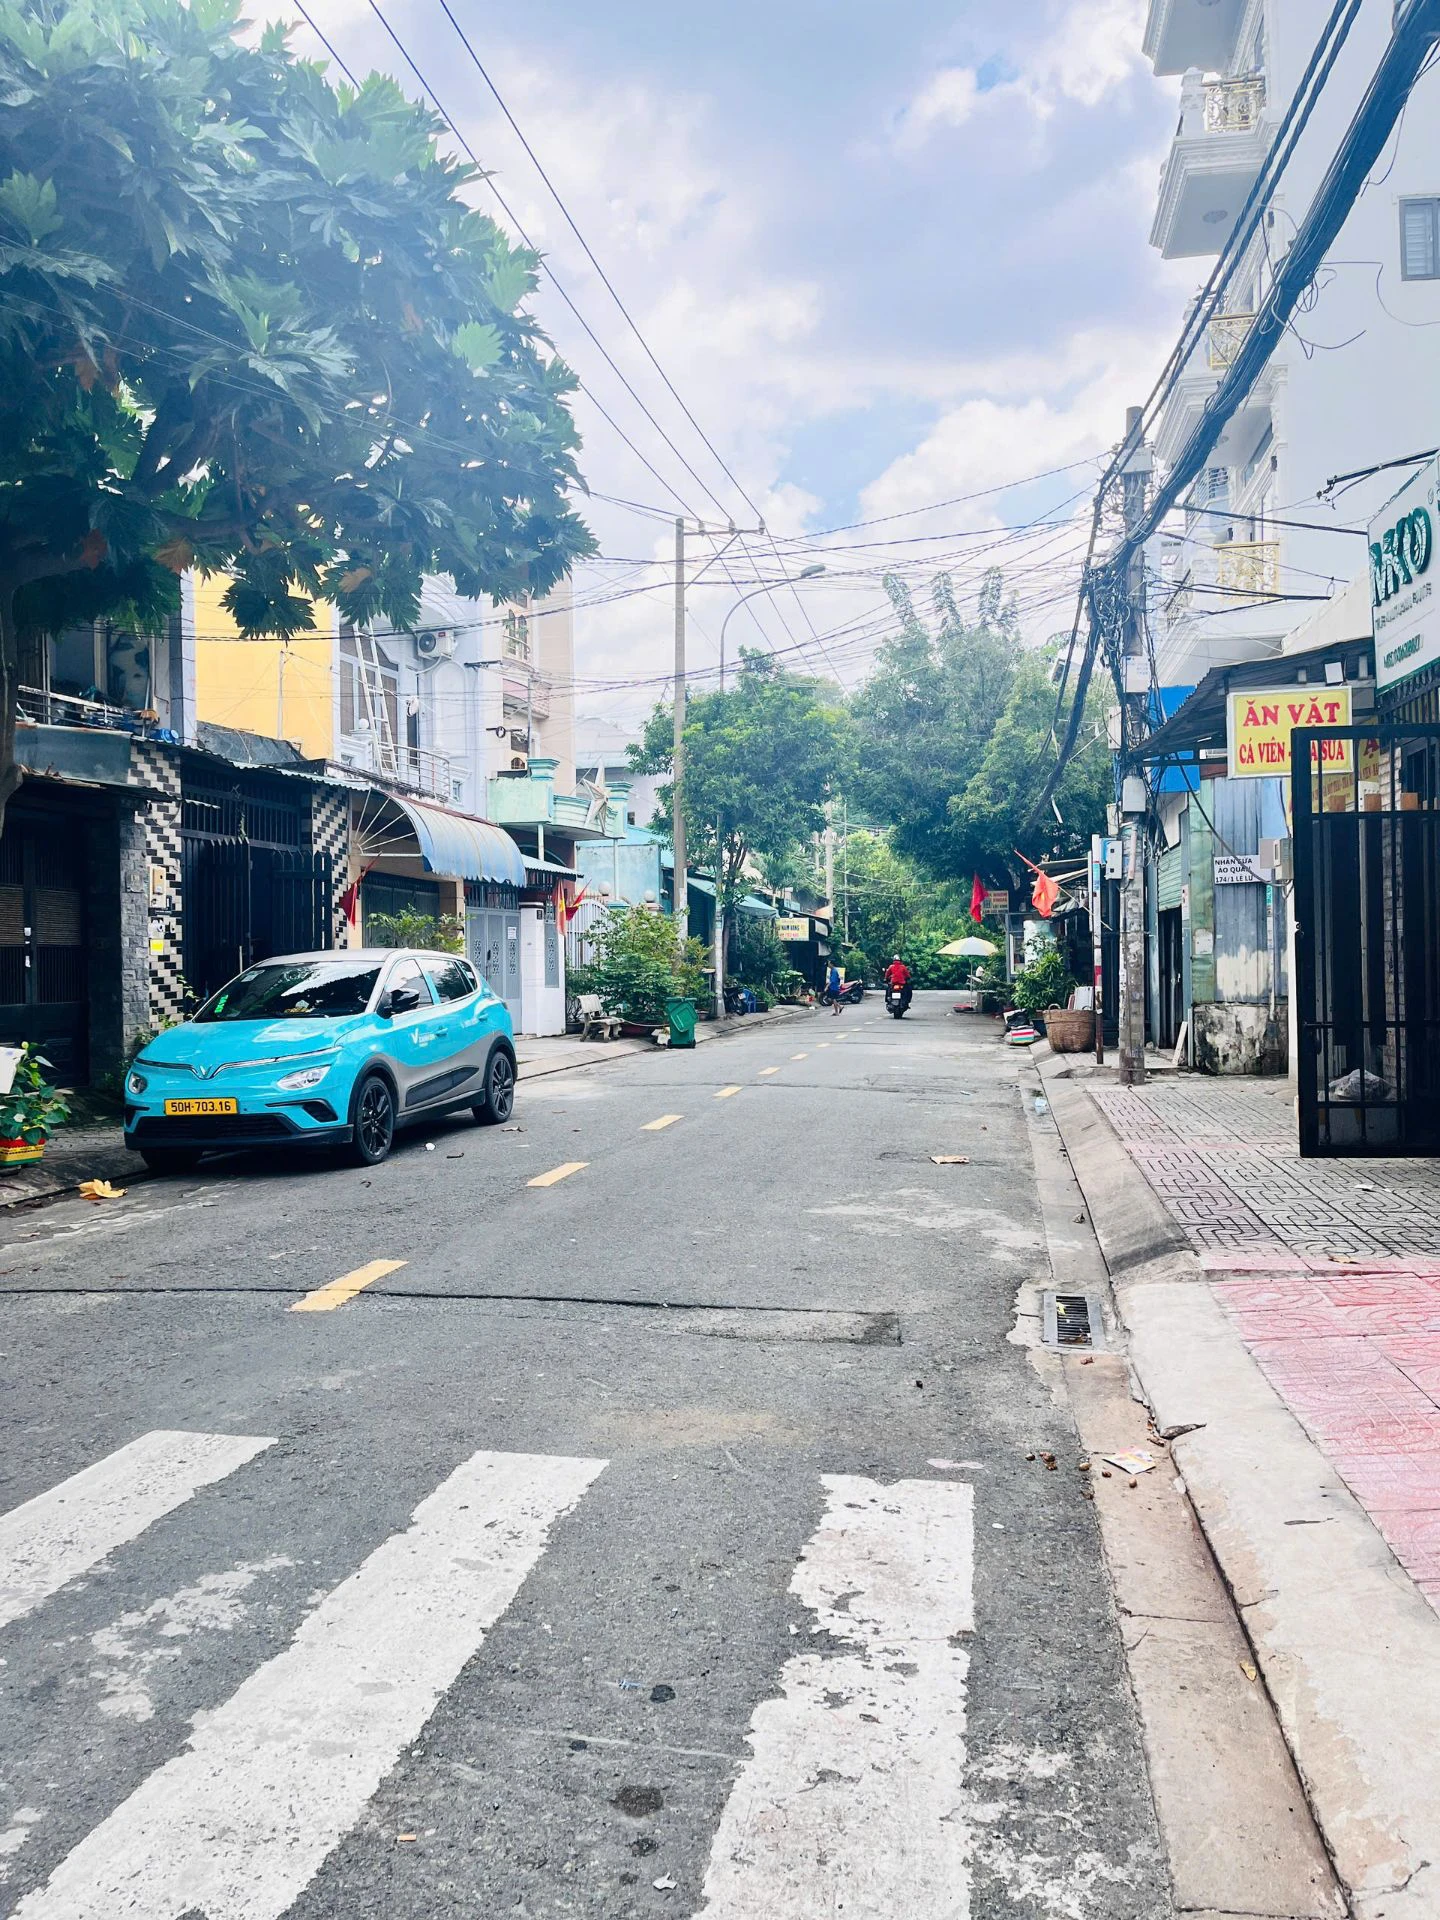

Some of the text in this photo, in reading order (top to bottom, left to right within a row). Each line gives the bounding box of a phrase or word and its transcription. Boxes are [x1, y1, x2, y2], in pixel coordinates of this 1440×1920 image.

[1243, 699, 1279, 727] ĂN
[1239, 737, 1255, 764] CÁ
[1258, 736, 1285, 763] VIÊN
[171, 1101, 231, 1112] 50H-703.16
